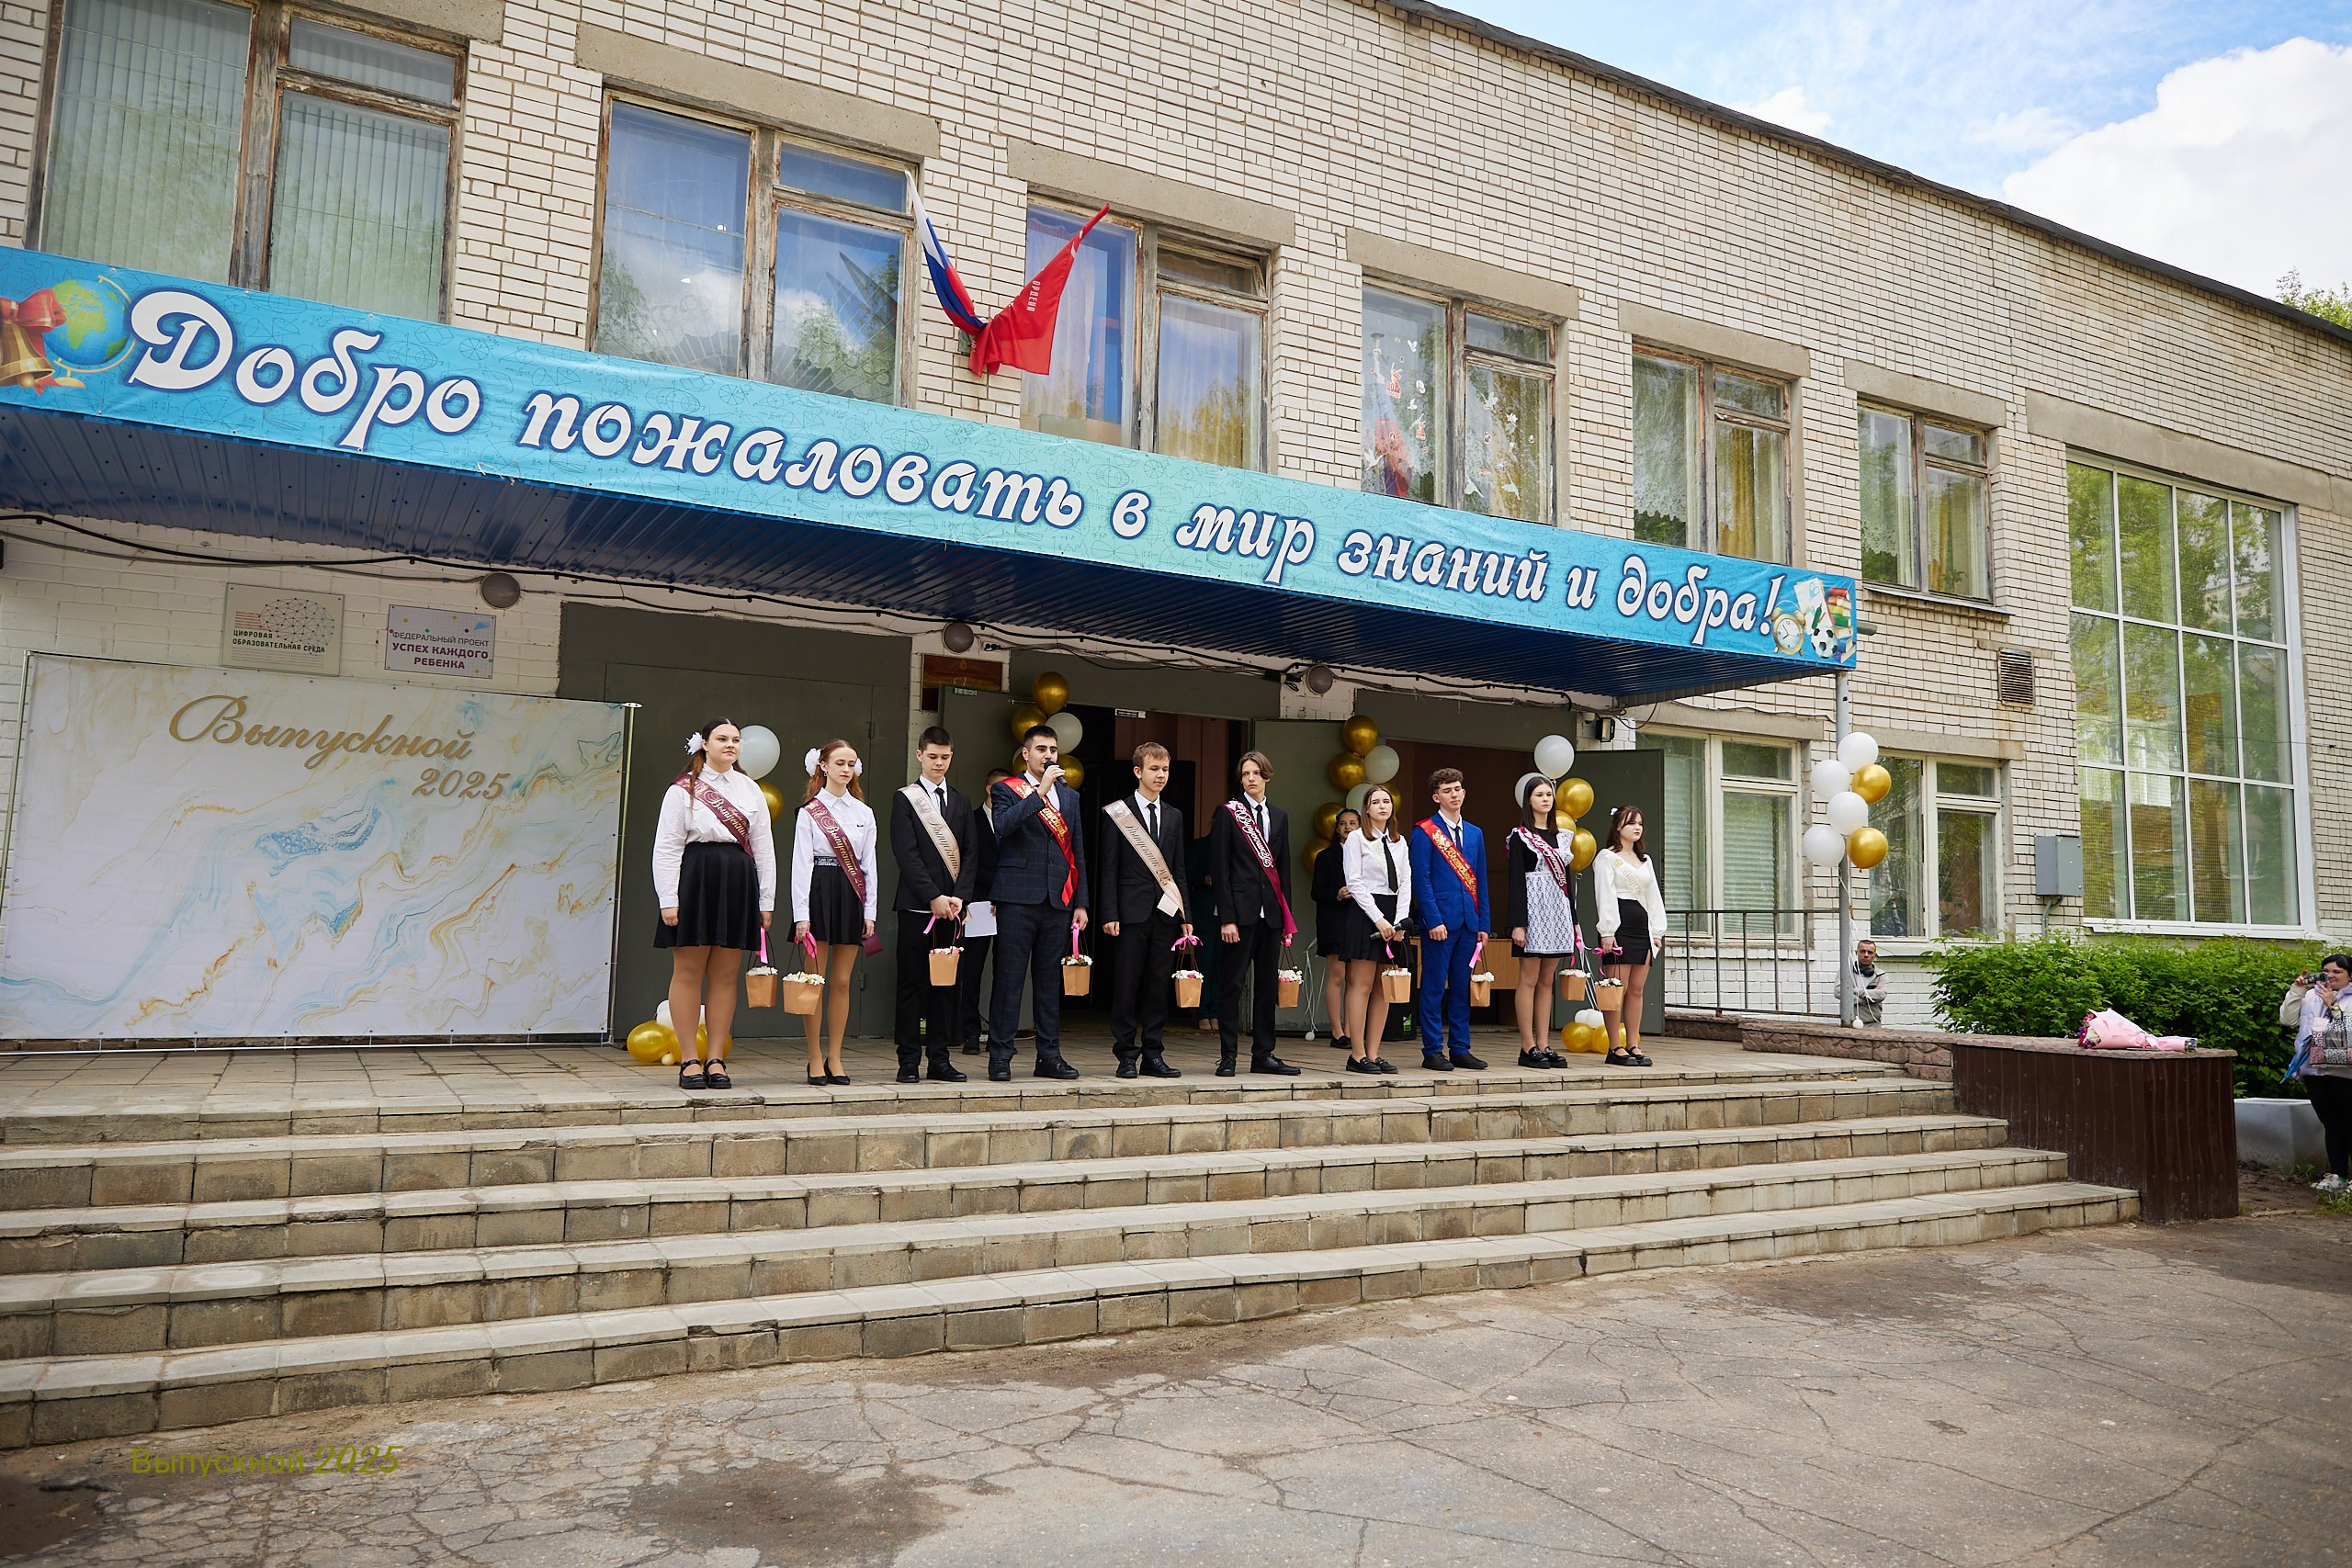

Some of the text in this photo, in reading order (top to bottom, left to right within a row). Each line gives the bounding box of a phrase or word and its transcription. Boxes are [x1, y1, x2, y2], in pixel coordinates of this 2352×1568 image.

[1026, 280, 1041, 311] ОРДЕНА
[126, 288, 1786, 646] Добро пожаловать в мир знаний и добра!
[233, 629, 273, 638] ЦИФРОВАЯ
[392, 631, 490, 648] ФЕДЕРАЛЬНЫЙ ПРОЕКТ
[232, 638, 325, 653] ОБРАЗОВАТЕЛЬНАЯ СРЕДА
[392, 642, 489, 659] УСПЕХ КАЖДОГО
[413, 657, 465, 669] РЕБЕНКА
[169, 694, 476, 769] Выпускной
[412, 767, 511, 800] 2025
